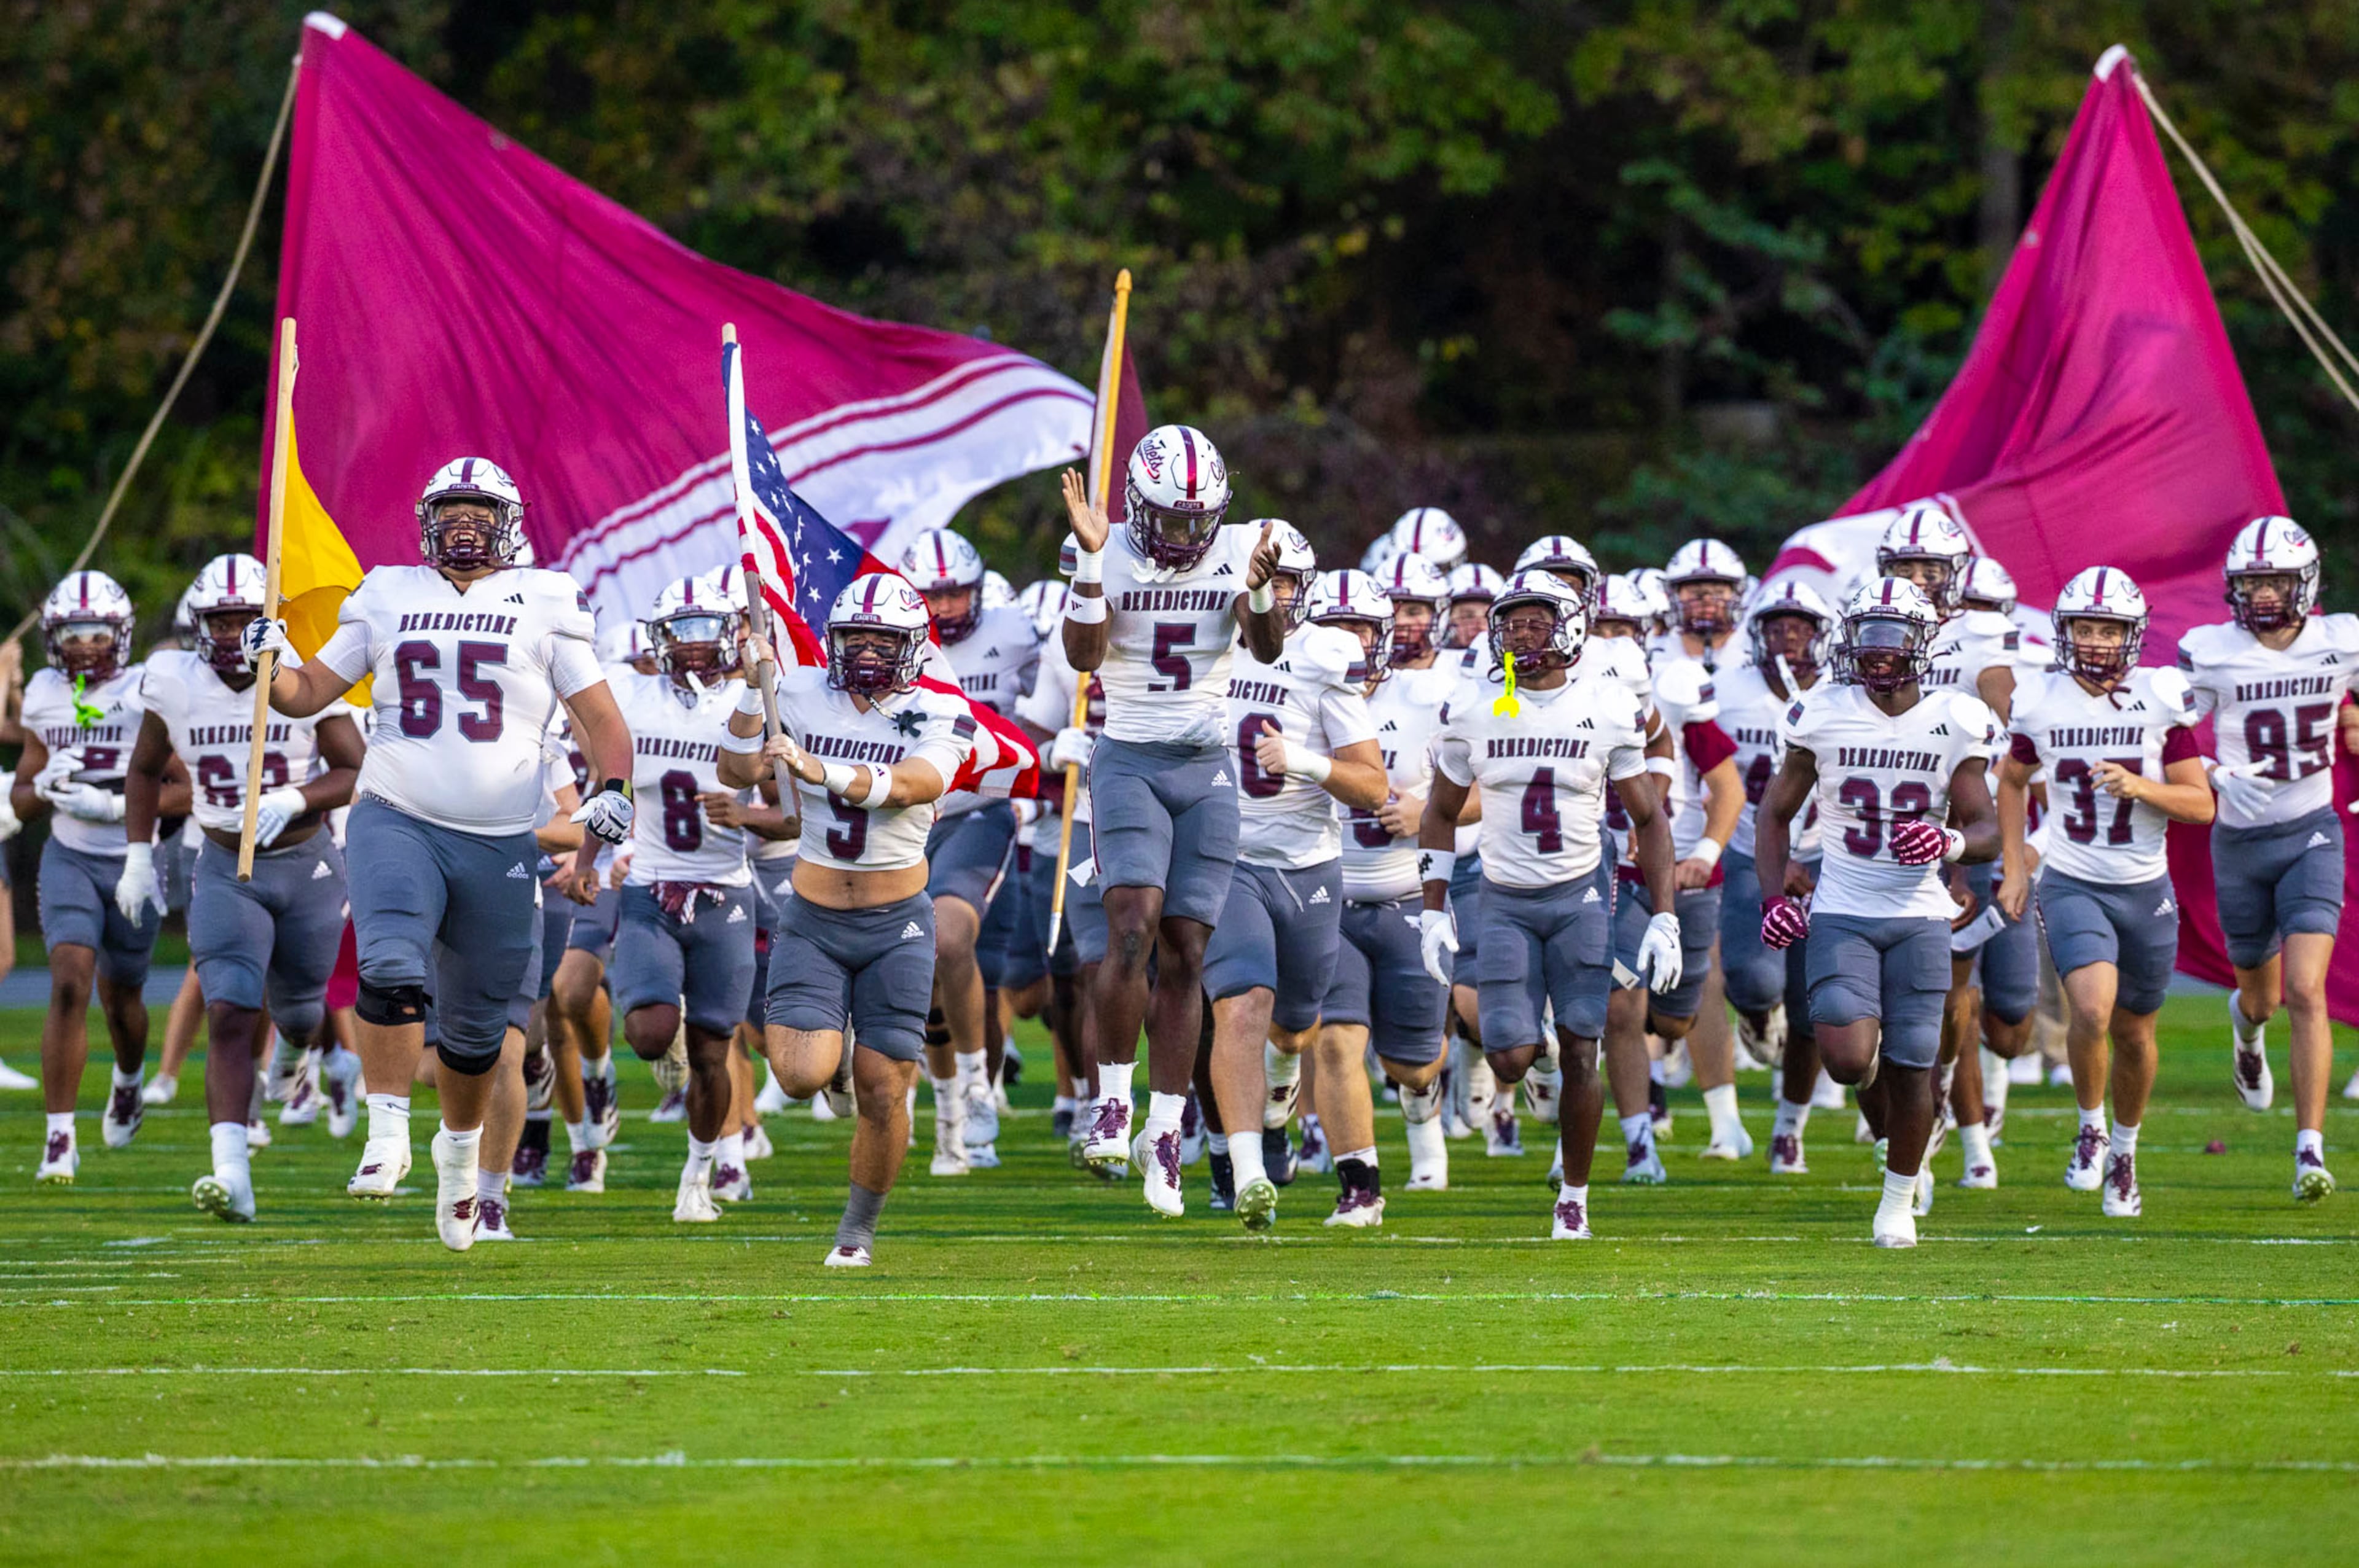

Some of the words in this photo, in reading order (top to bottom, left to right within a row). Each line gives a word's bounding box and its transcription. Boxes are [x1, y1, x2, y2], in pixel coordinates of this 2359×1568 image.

[1122, 590, 1227, 610] BENEDICTINE
[397, 613, 518, 635] BENEDICTINE
[1148, 622, 1196, 692] 5
[394, 639, 508, 743] 65
[2236, 676, 2333, 702] BENEDICTINE
[189, 724, 292, 746] BENEDICINE
[805, 734, 905, 764] BENEDICTINE
[1487, 738, 1589, 759] BENEDICTINE
[2049, 727, 2144, 747] BENEDICTINE
[1839, 747, 1941, 772] BENEDICTINE
[660, 769, 702, 852] 8
[1520, 767, 1563, 855] 4
[2055, 757, 2143, 847] 37
[1839, 776, 1931, 860] 32
